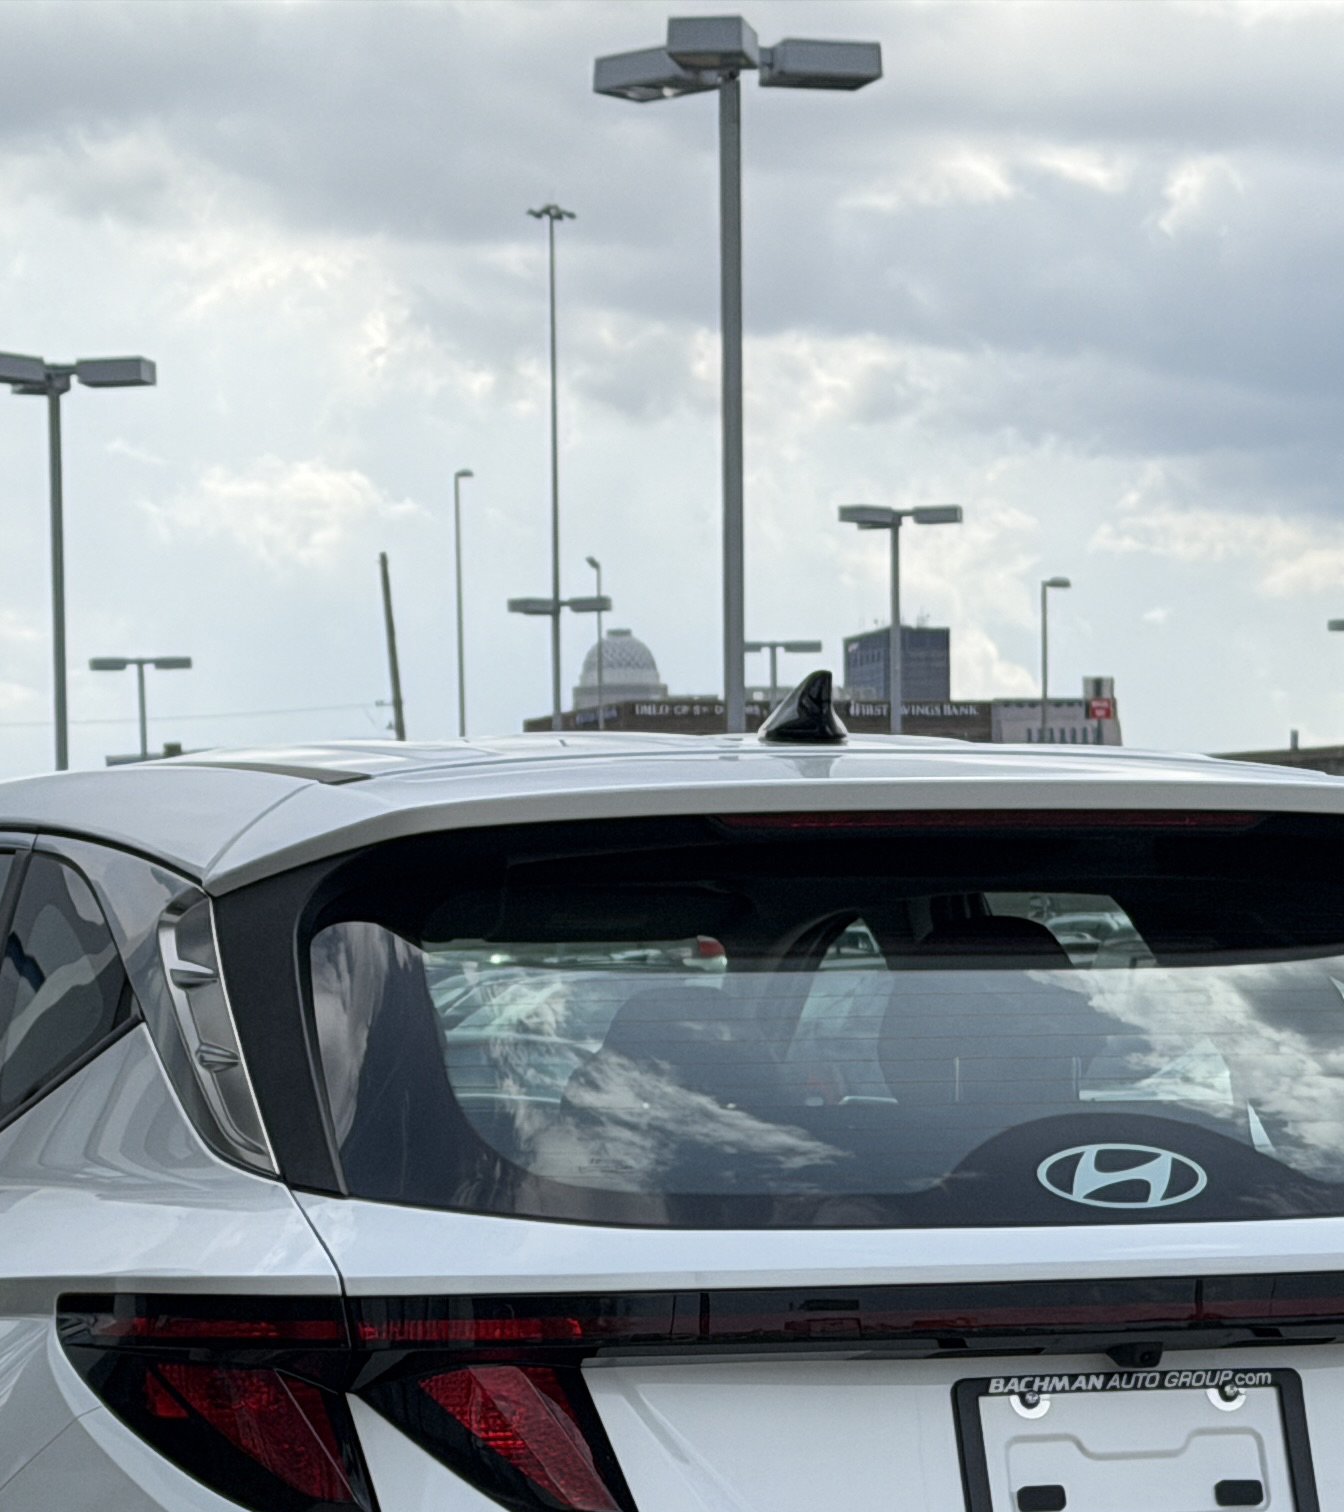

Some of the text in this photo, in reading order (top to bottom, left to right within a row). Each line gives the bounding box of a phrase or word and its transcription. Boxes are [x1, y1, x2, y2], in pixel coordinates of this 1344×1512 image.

[943, 703, 979, 716] BANK
[988, 1374, 1104, 1394] BACHMAN
[1106, 1372, 1160, 1389] AUTO
